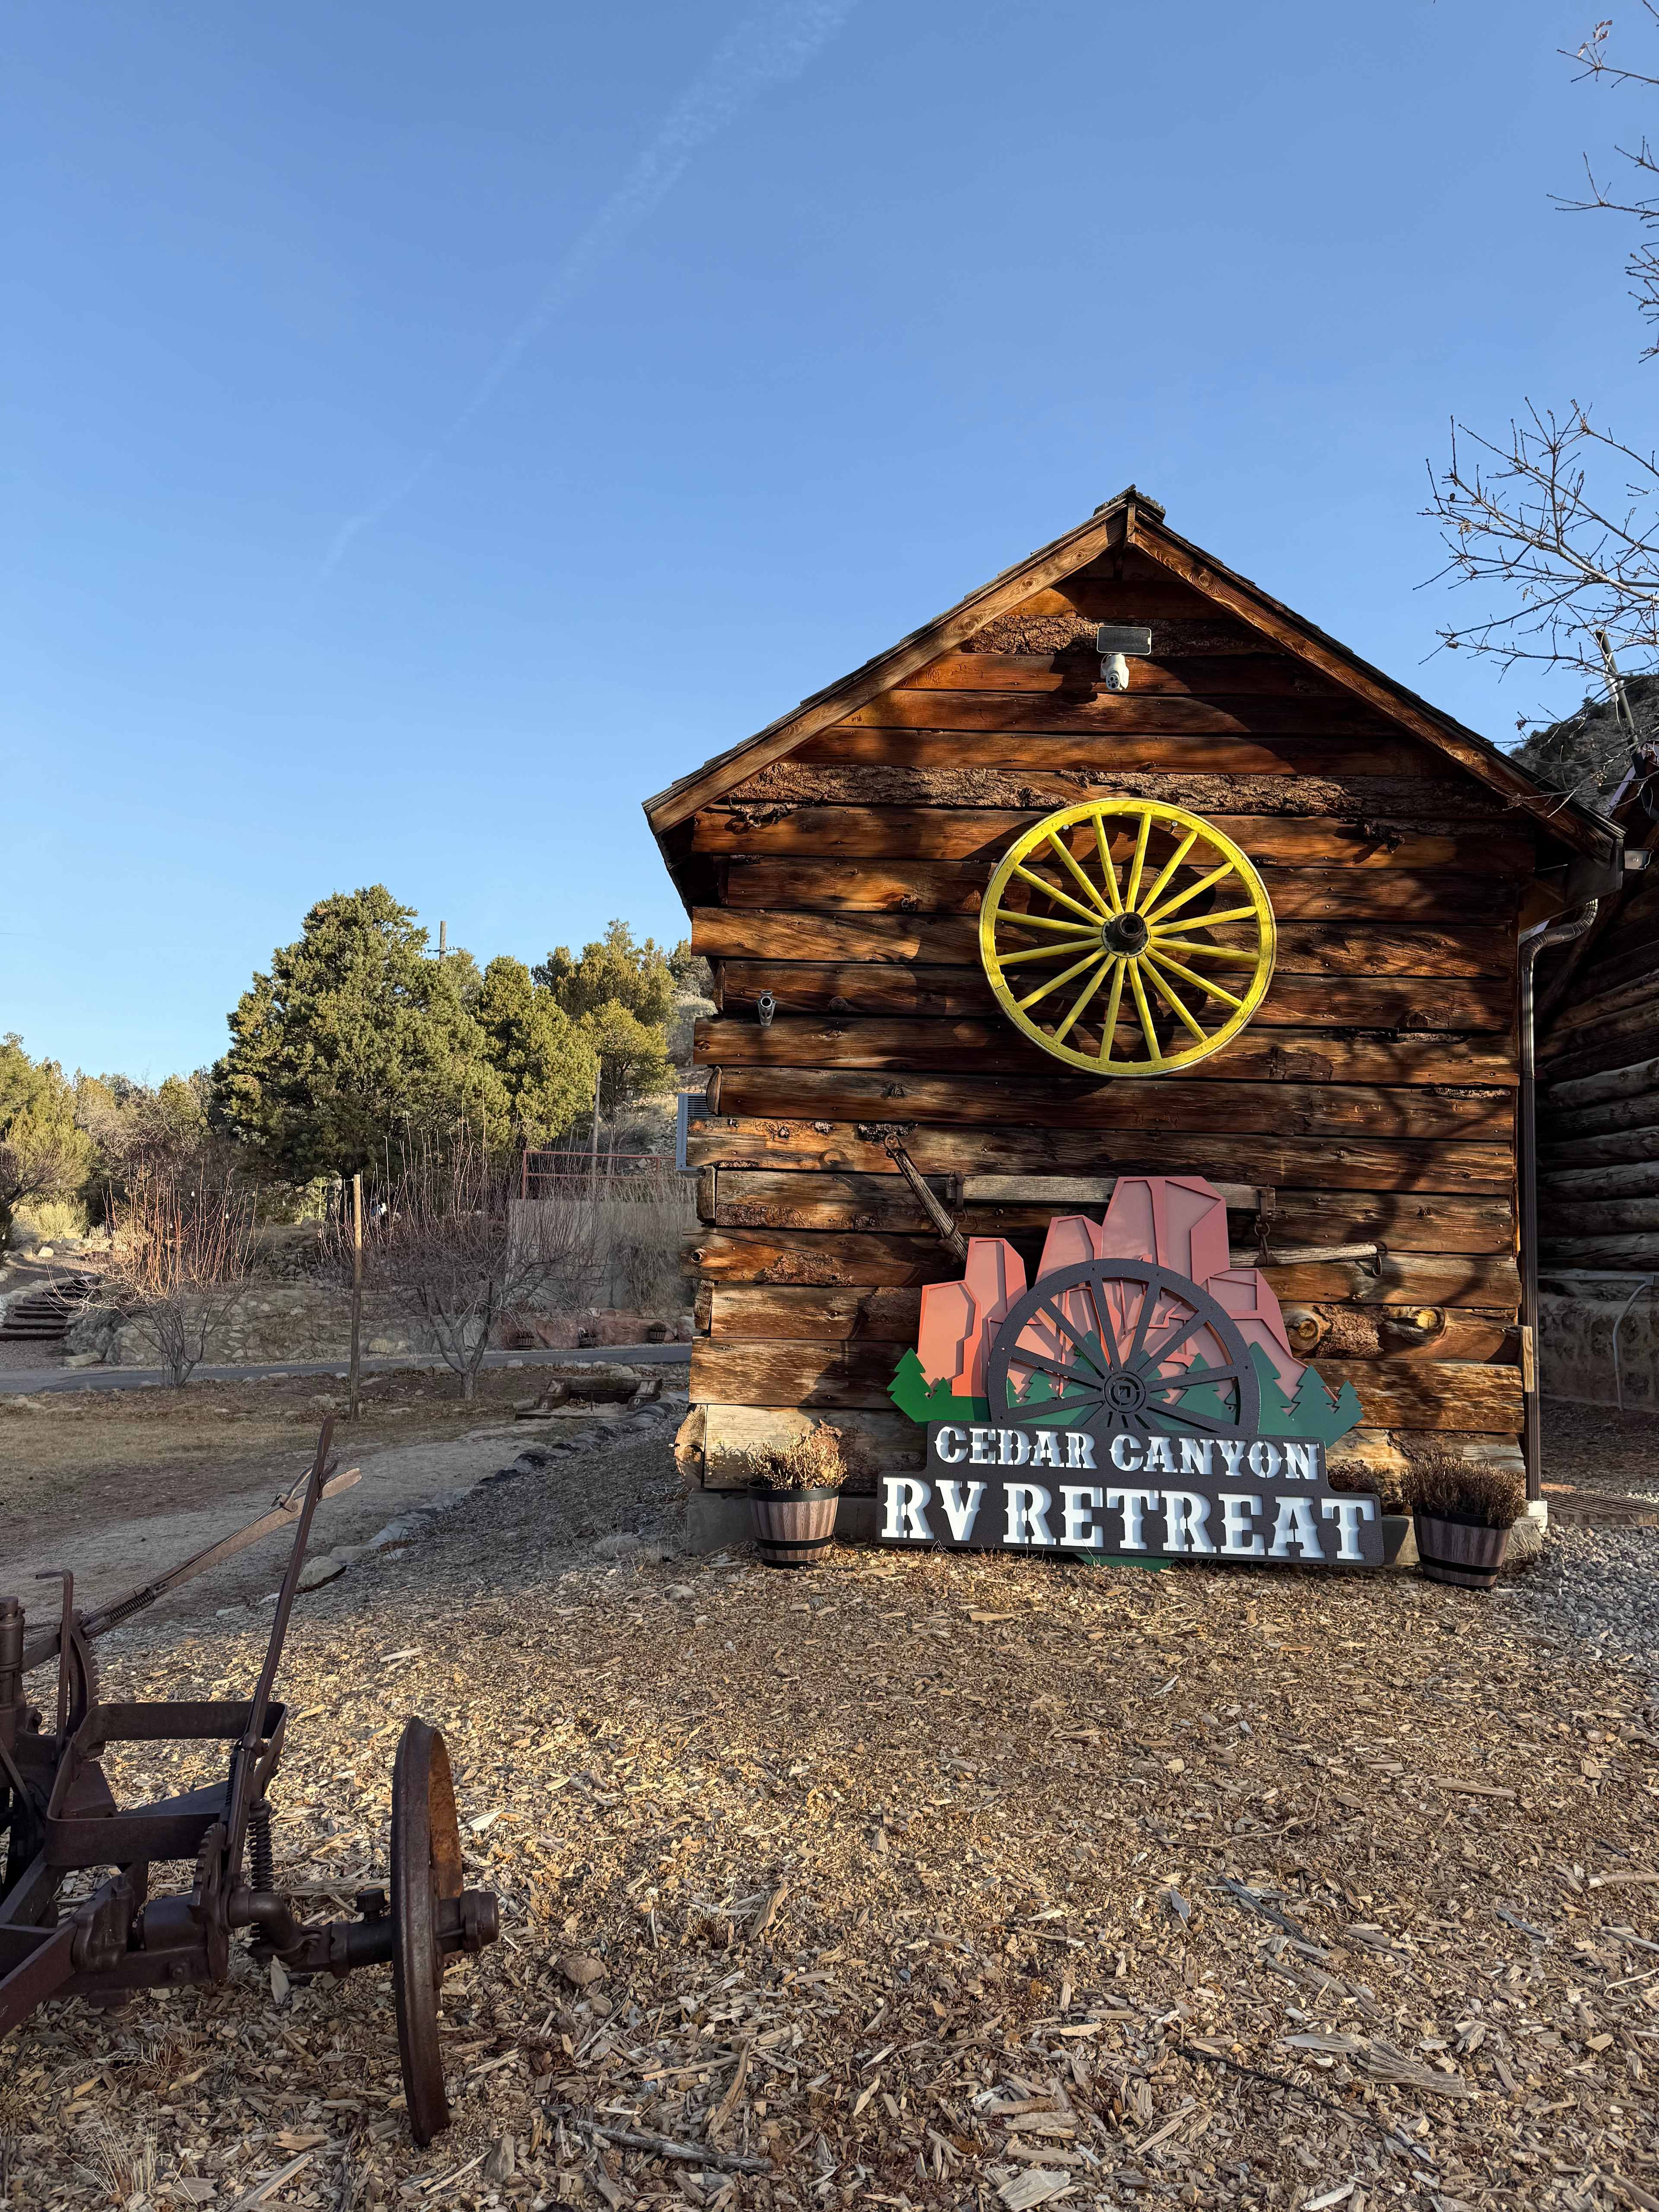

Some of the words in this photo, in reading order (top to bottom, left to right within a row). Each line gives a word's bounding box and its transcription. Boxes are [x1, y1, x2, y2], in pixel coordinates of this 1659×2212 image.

[934, 1426, 1097, 1469] CEDAR
[1110, 1434, 1320, 1480] CANYON
[881, 1477, 988, 1541] RV
[1003, 1482, 1375, 1560] RETREAT
